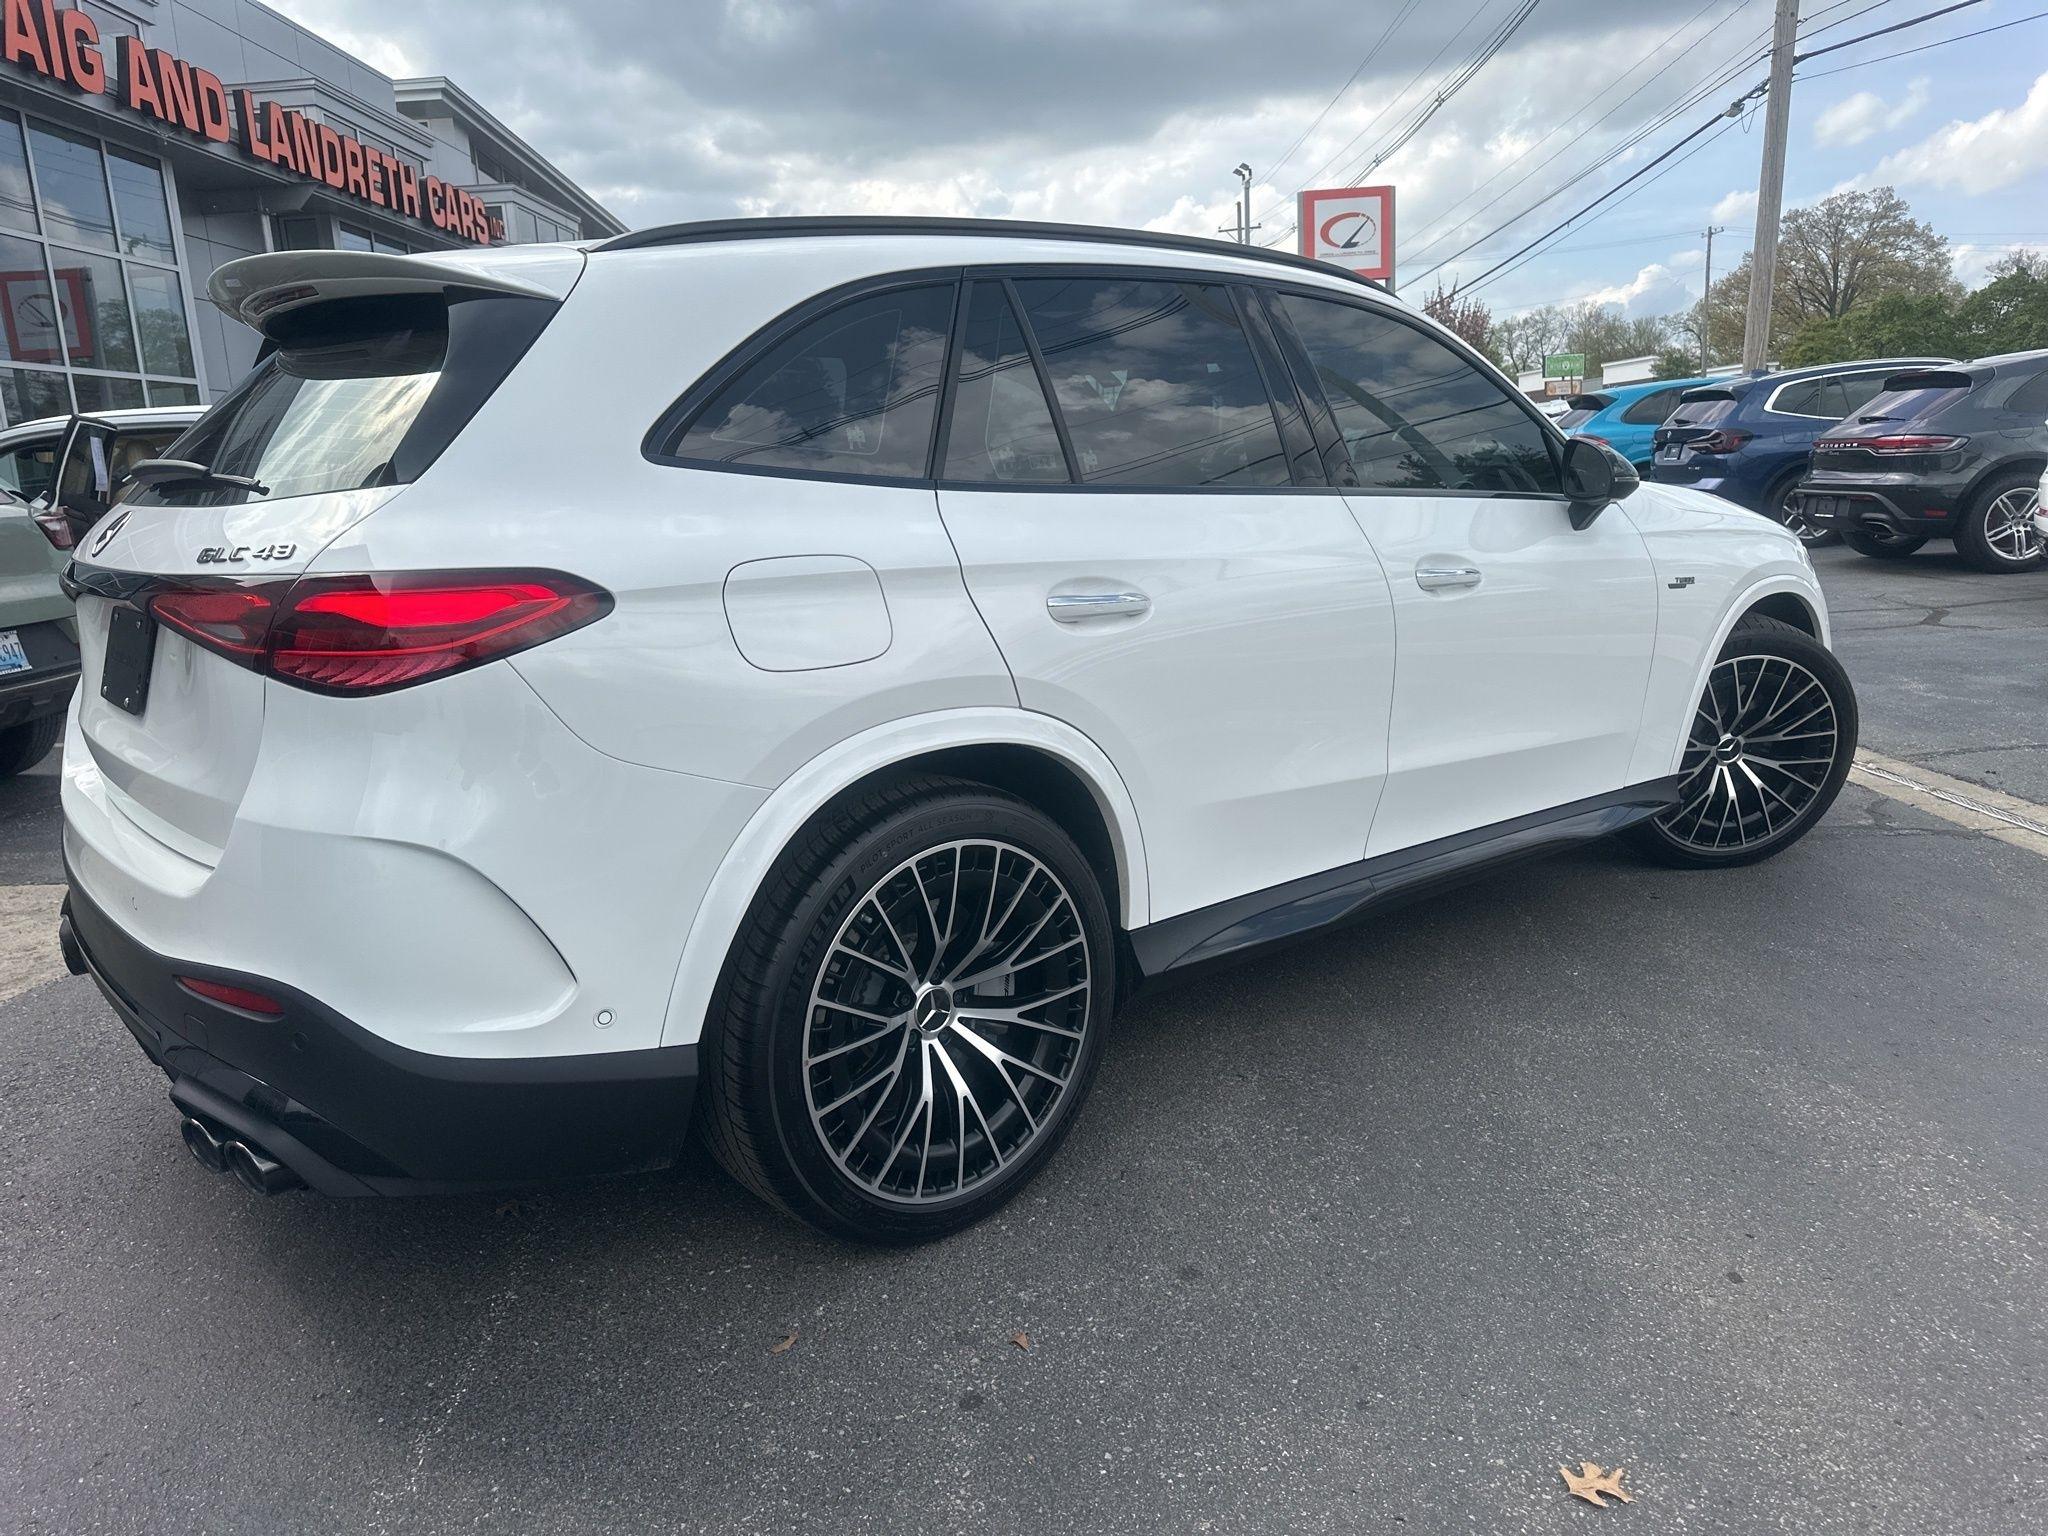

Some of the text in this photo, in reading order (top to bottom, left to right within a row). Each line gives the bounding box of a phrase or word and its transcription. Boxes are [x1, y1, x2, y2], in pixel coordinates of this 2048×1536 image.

[127, 35, 230, 143] AND
[242, 88, 421, 219] LANDRETH
[426, 175, 489, 245] CARS
[196, 543, 298, 564] GLC 43
[786, 875, 857, 1005] ICHELIN
